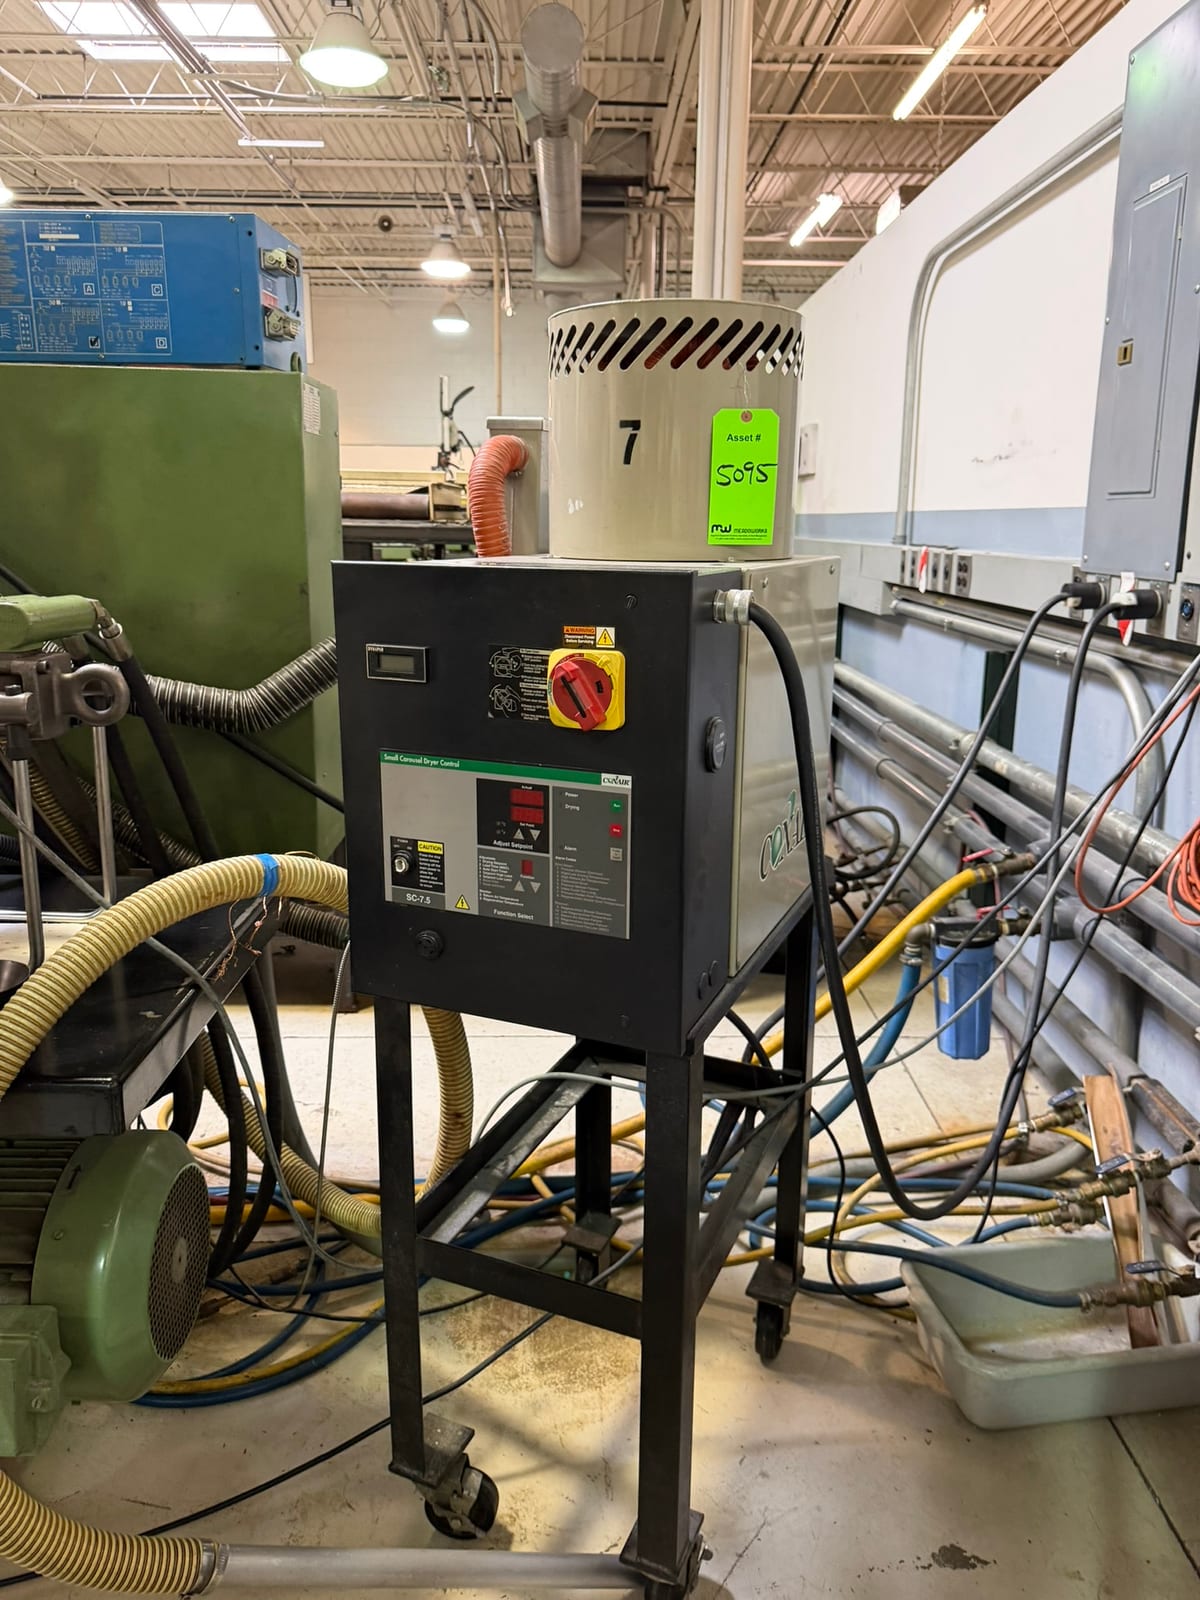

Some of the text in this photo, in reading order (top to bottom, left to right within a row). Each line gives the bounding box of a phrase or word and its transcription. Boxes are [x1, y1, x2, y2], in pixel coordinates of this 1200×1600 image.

[619, 420, 641, 464] 7
[726, 433, 761, 442] Asset #
[716, 461, 778, 486] 5095
[384, 753, 460, 768] Small Carousel Dryer Control
[419, 843, 441, 851] CAUTION
[511, 842, 533, 850] Setpoint
[406, 893, 431, 904] SC-7.5
[493, 909, 517, 918] Function
